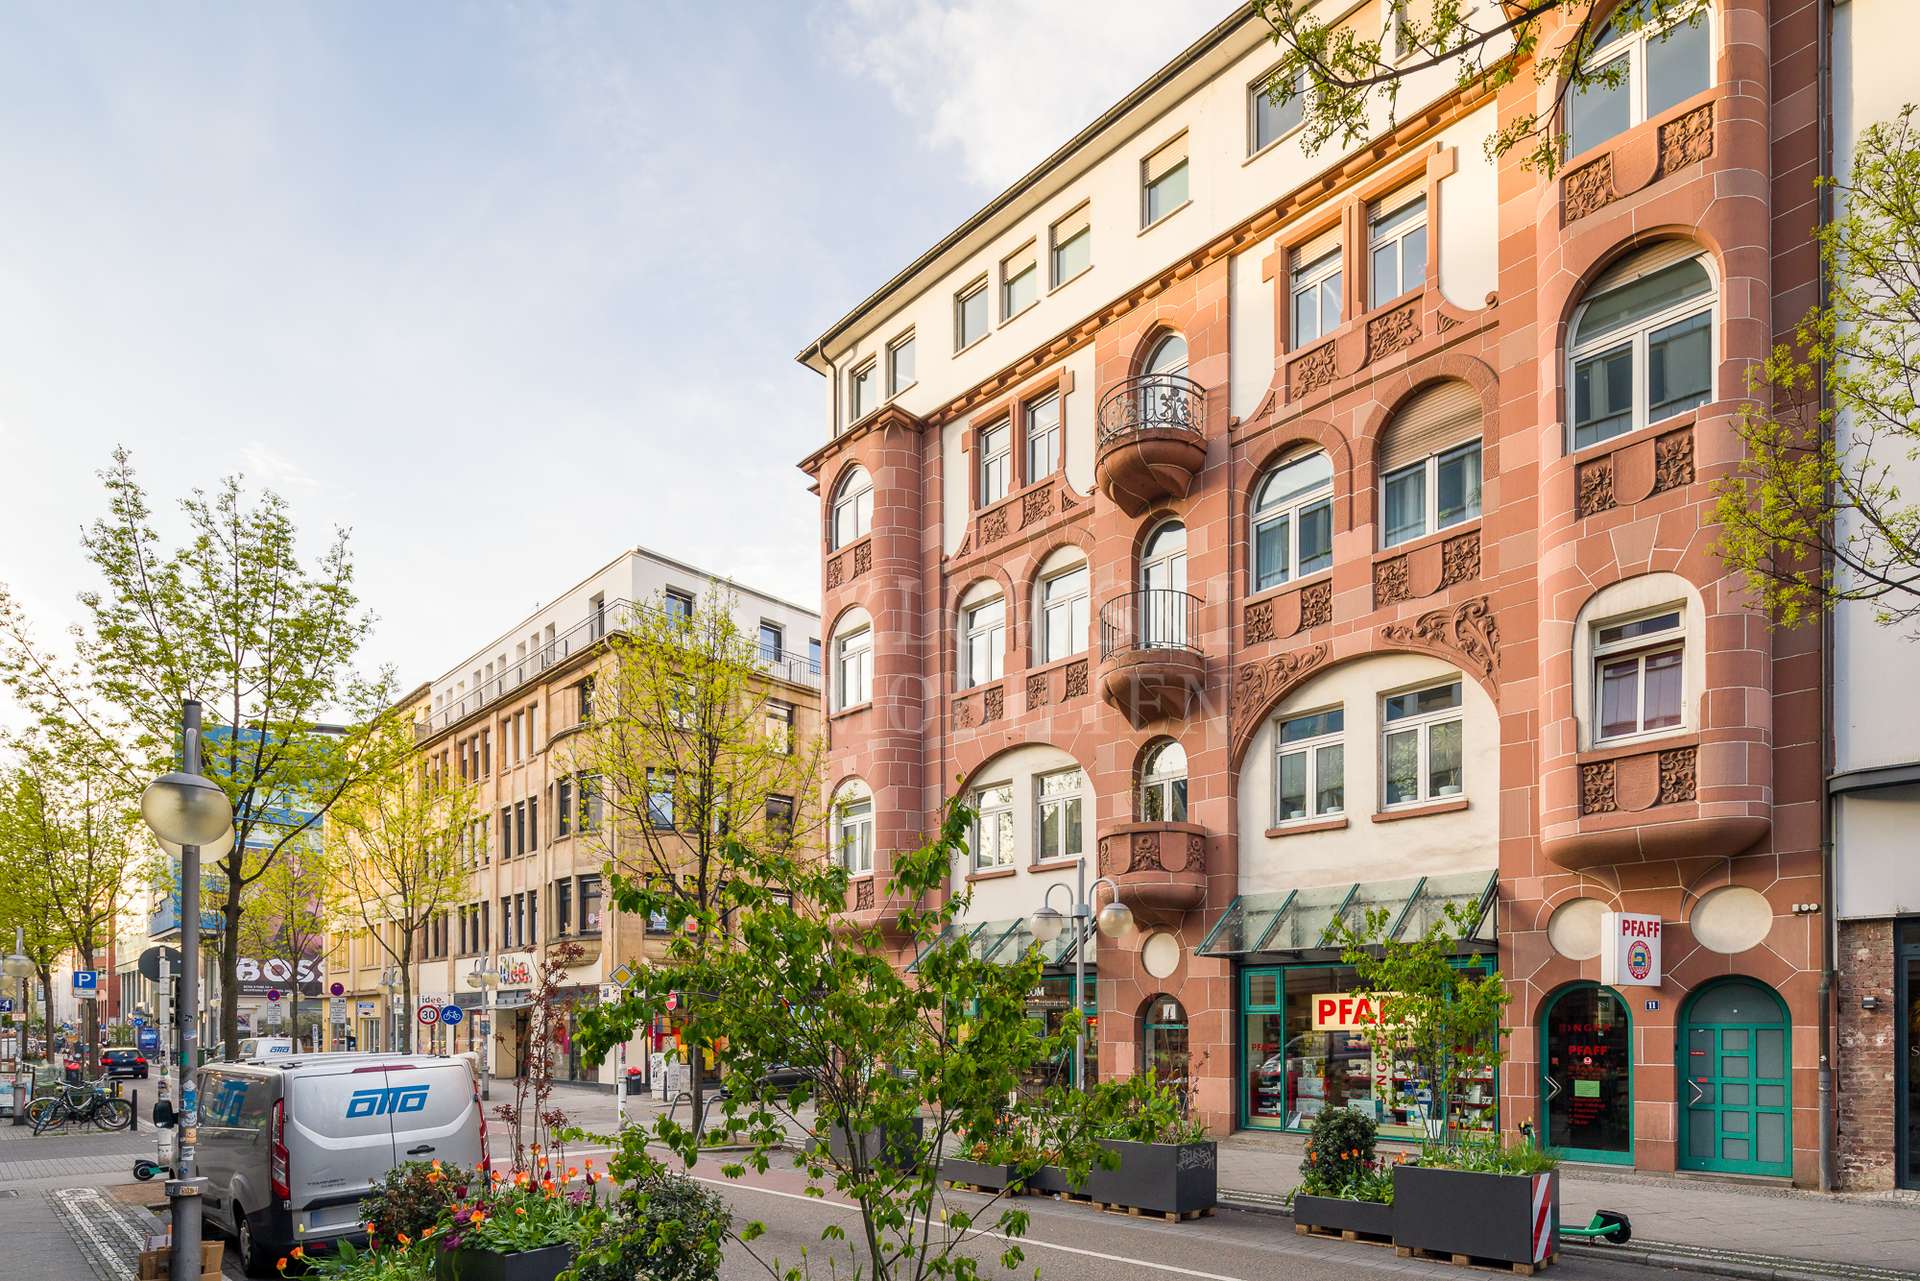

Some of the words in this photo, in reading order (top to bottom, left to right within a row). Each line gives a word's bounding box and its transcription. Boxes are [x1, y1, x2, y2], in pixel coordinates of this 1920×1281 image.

[1622, 919, 1660, 938] PFAFF
[78, 973, 92, 987] P
[1318, 999, 1406, 1025] PFA
[1648, 1001, 1656, 1011] 11
[421, 1010, 436, 1020] 30
[1568, 1045, 1609, 1055] PFAFF
